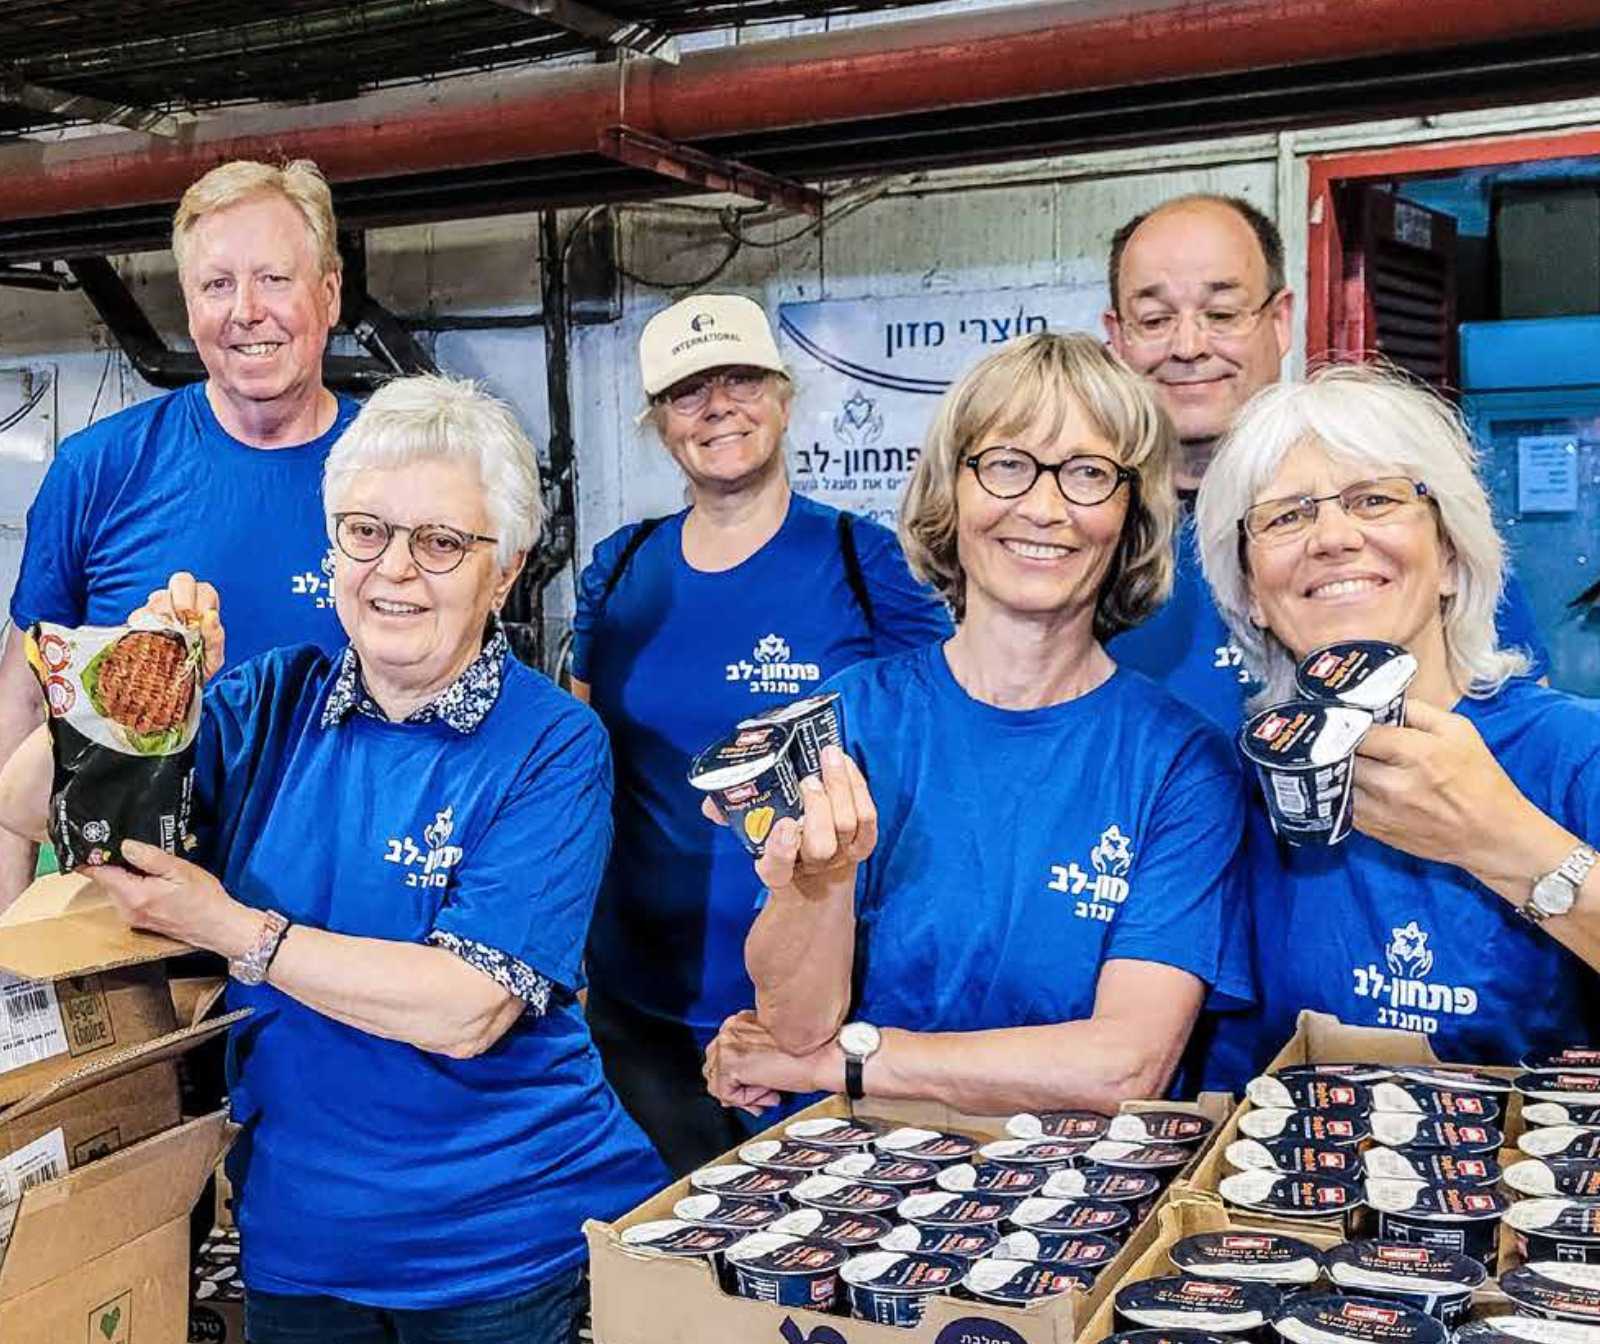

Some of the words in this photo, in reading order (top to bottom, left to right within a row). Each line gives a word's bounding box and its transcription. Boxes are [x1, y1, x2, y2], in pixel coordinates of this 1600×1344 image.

[671, 331, 742, 355] INTERNATIONAL
[886, 319, 945, 358] מזון
[725, 660, 820, 681] פתחון-לב
[1352, 964, 1478, 1015] פתחון-לב
